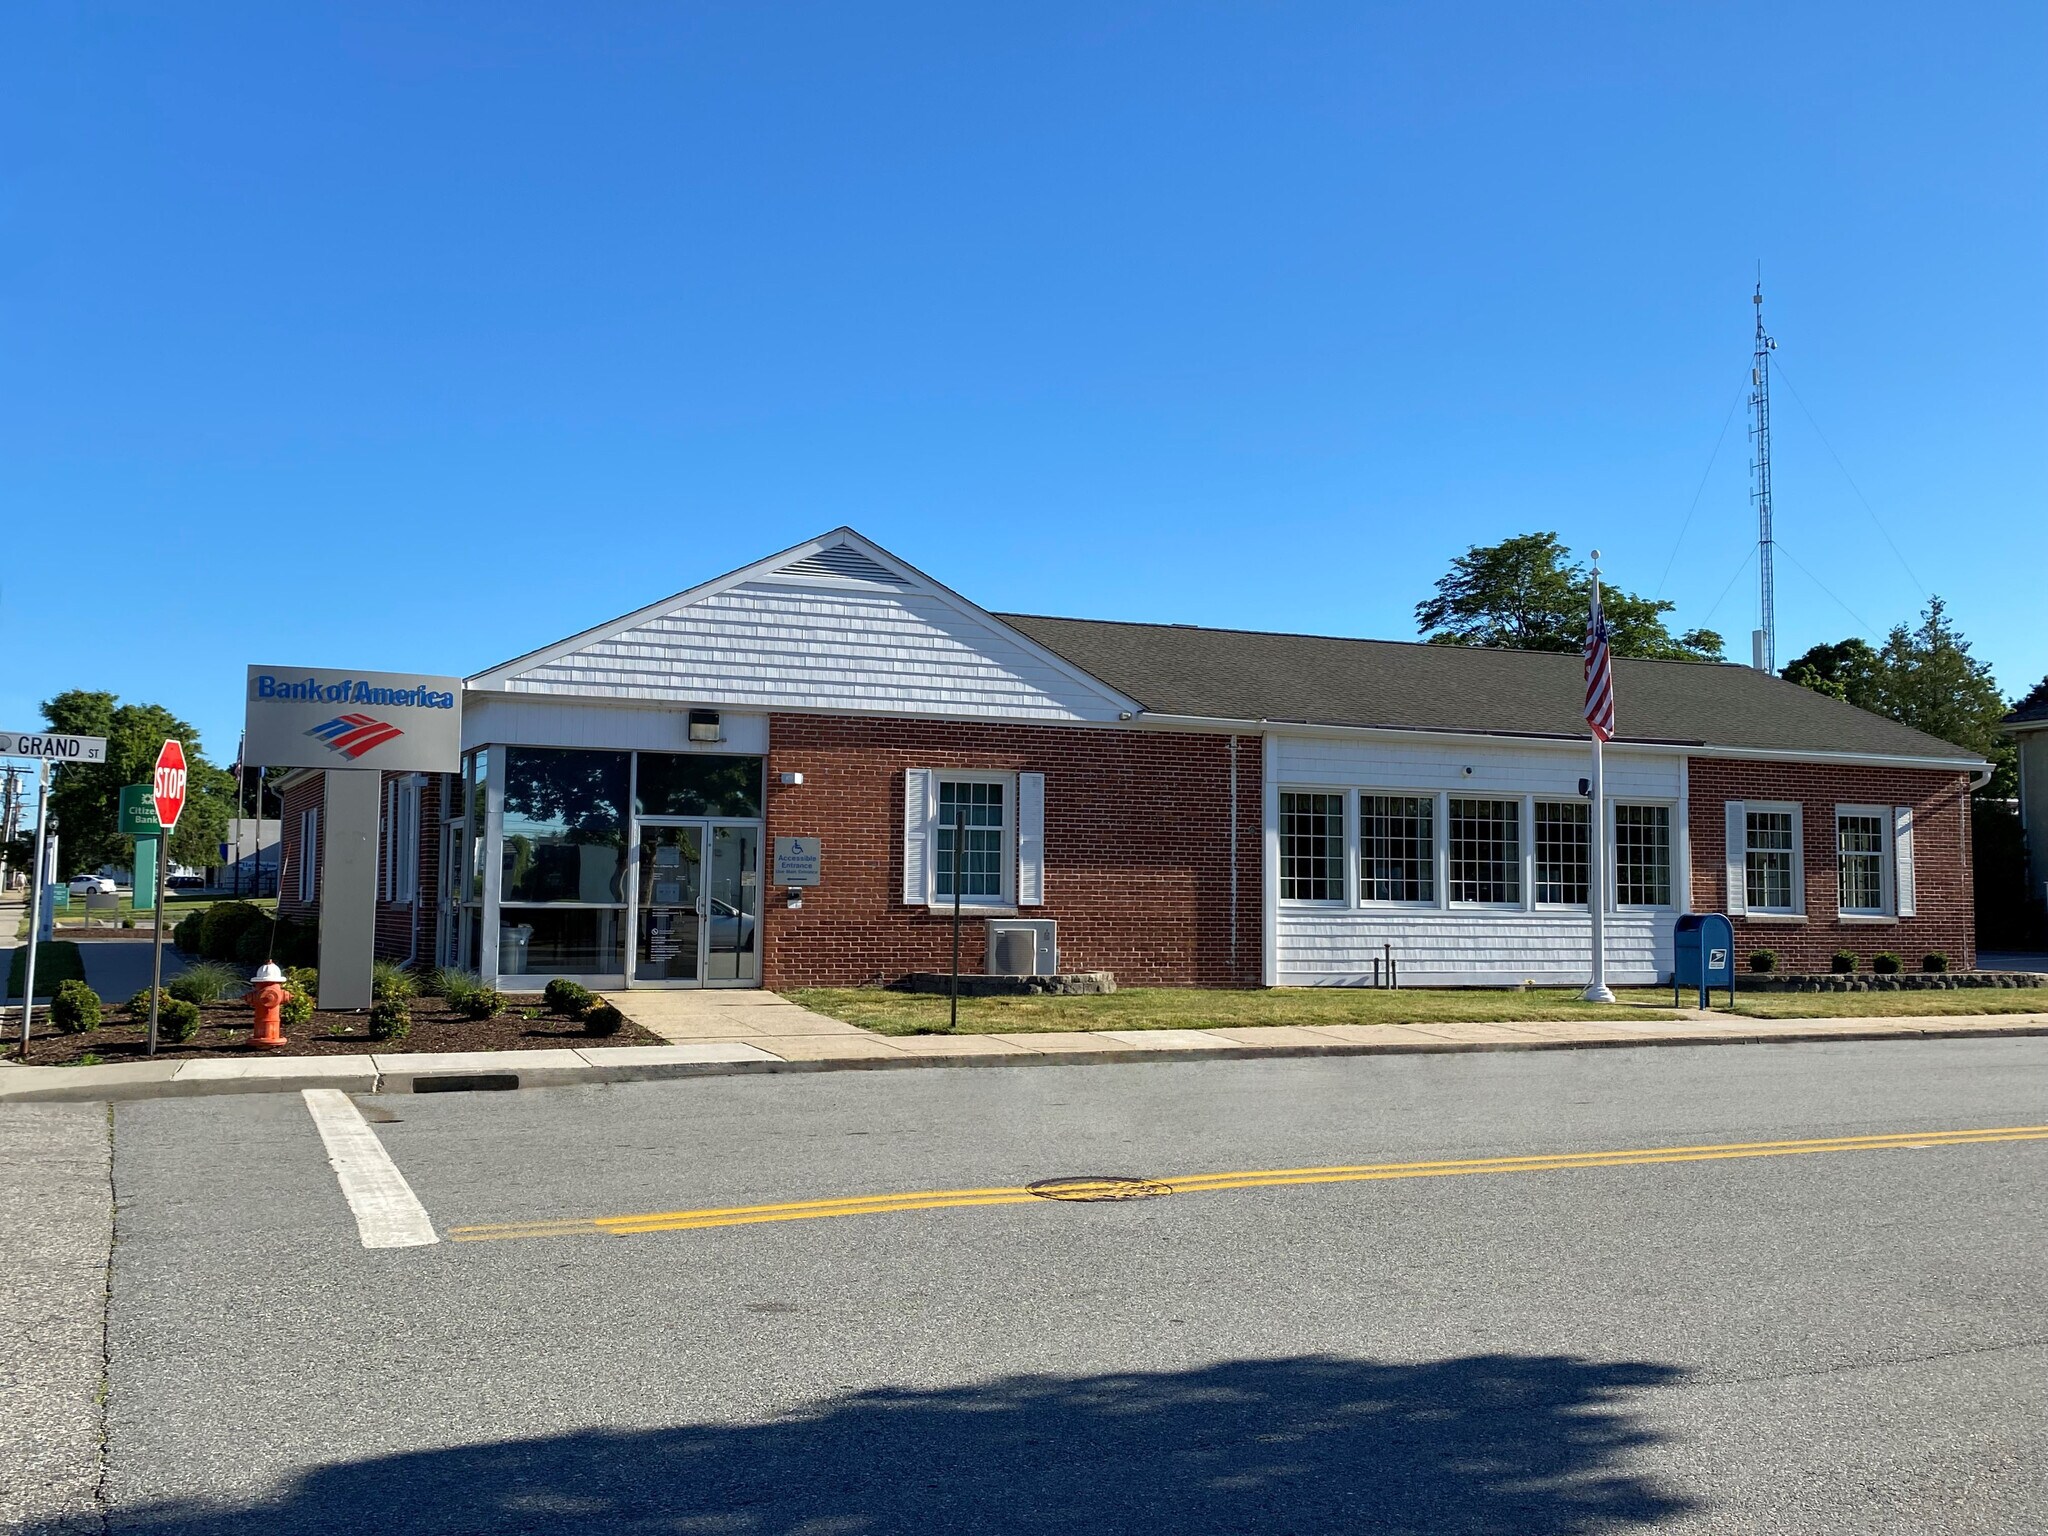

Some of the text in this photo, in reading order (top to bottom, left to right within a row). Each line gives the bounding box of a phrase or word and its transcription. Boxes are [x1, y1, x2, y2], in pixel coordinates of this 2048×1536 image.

[258, 675, 454, 709] Bank of America
[18, 736, 100, 759] GRAND ST
[155, 767, 186, 799] STOP
[129, 807, 157, 815] Citize
[135, 815, 158, 824] Bank
